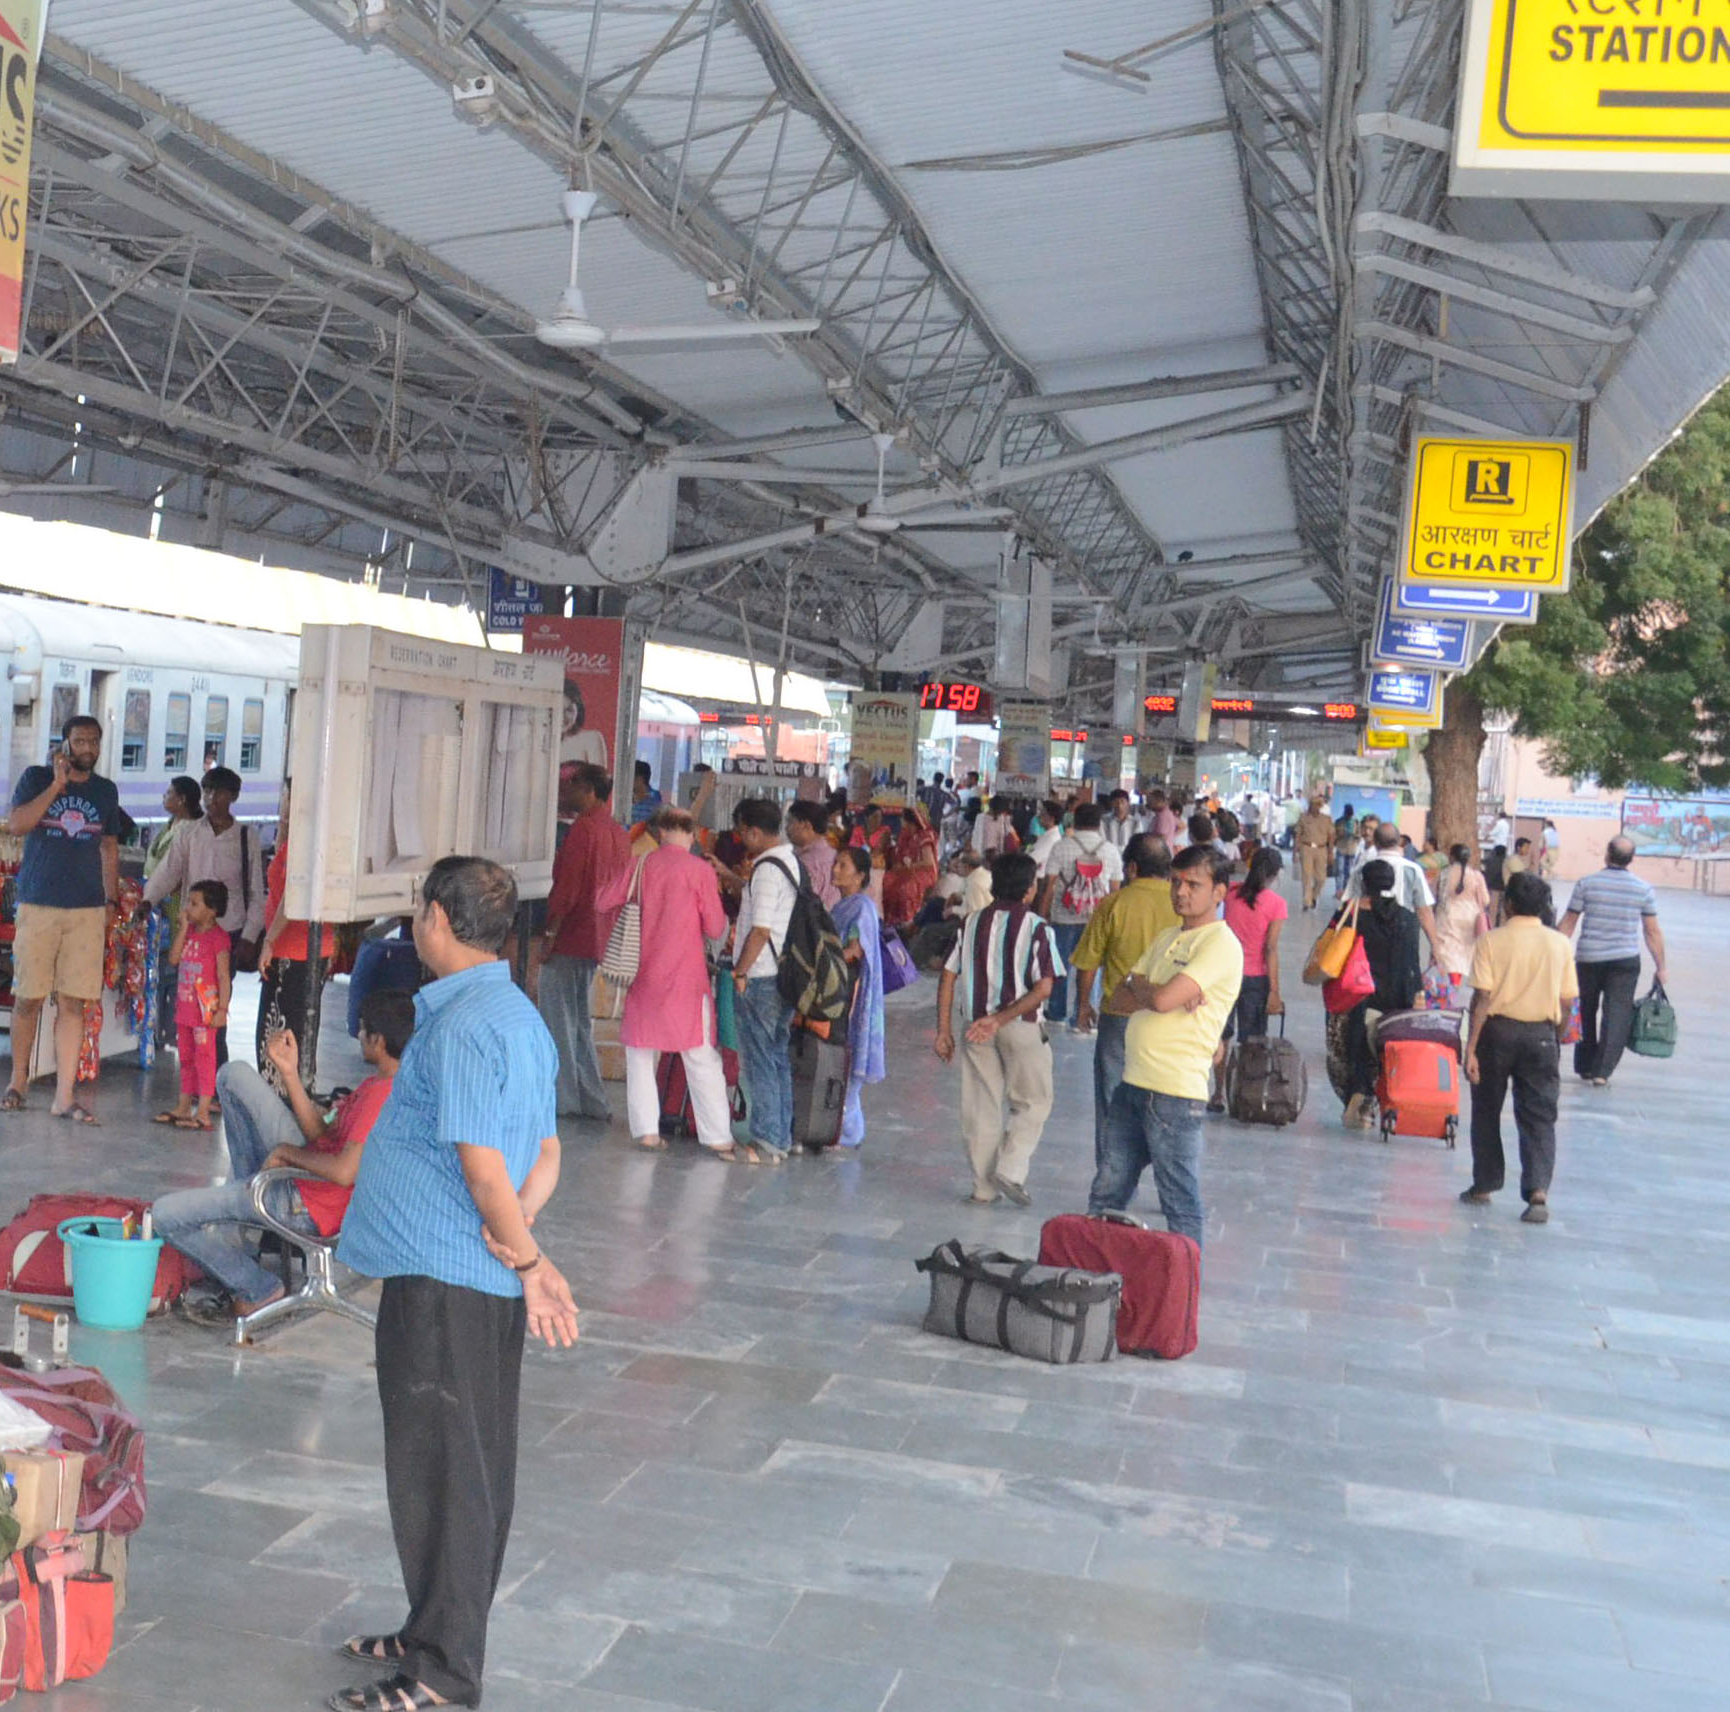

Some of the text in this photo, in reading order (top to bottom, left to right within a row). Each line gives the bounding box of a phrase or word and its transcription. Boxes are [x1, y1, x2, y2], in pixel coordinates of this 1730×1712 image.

[1476, 460, 1501, 493] R
[1421, 522, 1552, 550] आरक्षण चार्ट
[1424, 550, 1545, 575] CHART
[492, 615, 517, 626] COLD
